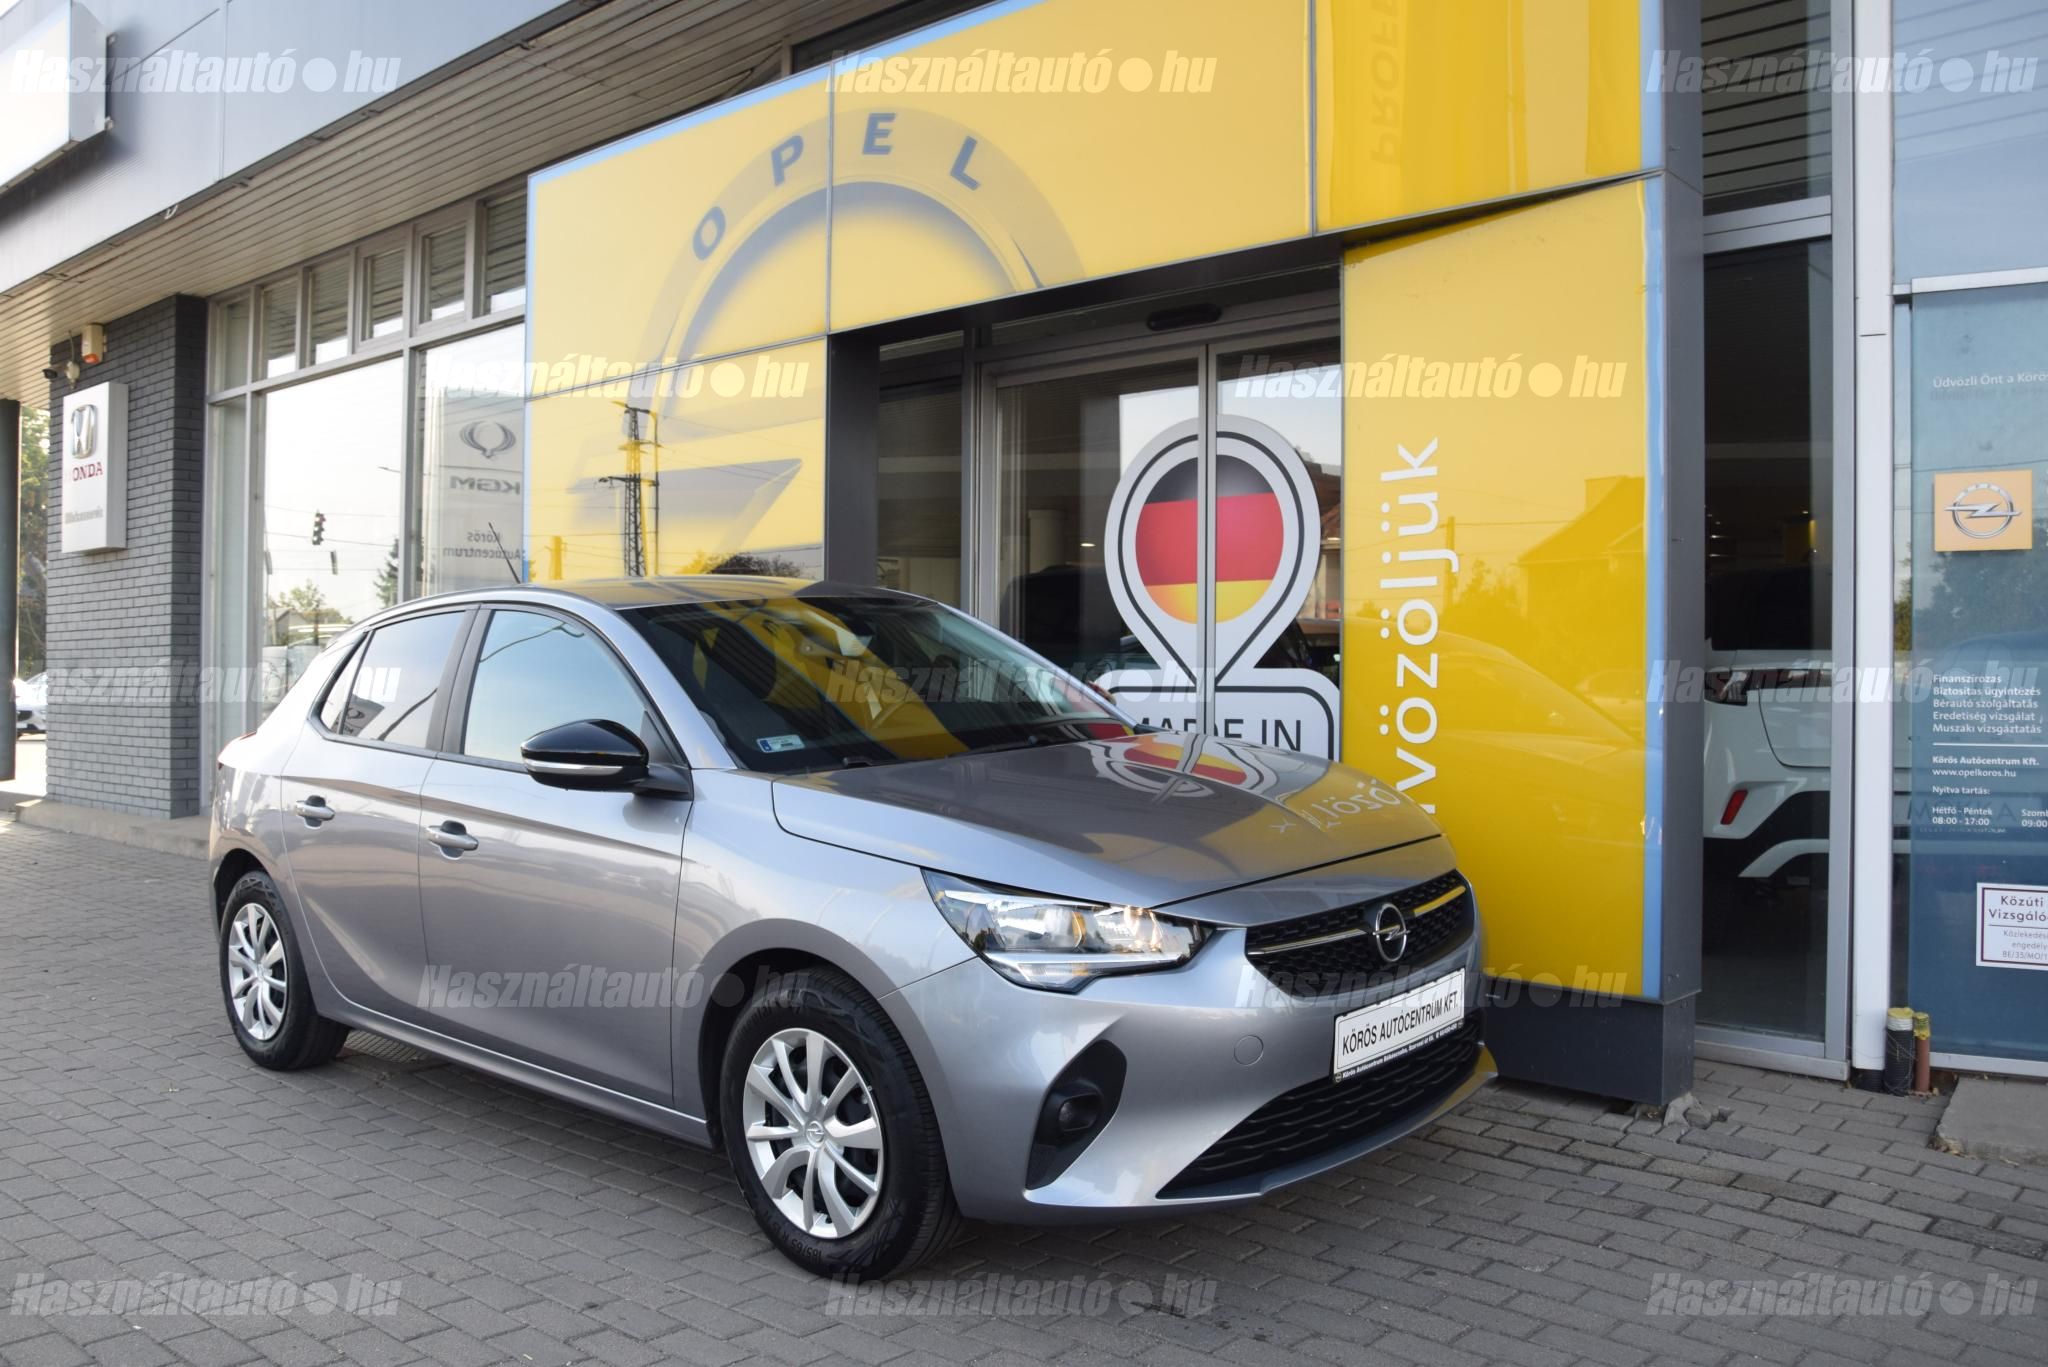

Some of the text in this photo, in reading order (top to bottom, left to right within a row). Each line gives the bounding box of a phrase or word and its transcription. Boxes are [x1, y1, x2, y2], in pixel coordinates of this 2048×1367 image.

[692, 112, 981, 261] OPEL
[66, 461, 104, 482] ONDA
[1261, 719, 1302, 751] IN
[1932, 769, 2017, 779] www.opelkoros.hu
[1932, 816, 1958, 825] 08:00
[1965, 817, 1990, 826] 17:00
[2000, 895, 2045, 908] Közúti
[1342, 1022, 1377, 1056] KÖRÖS
[1379, 1000, 1443, 1041] AUTÓCENTRUM
